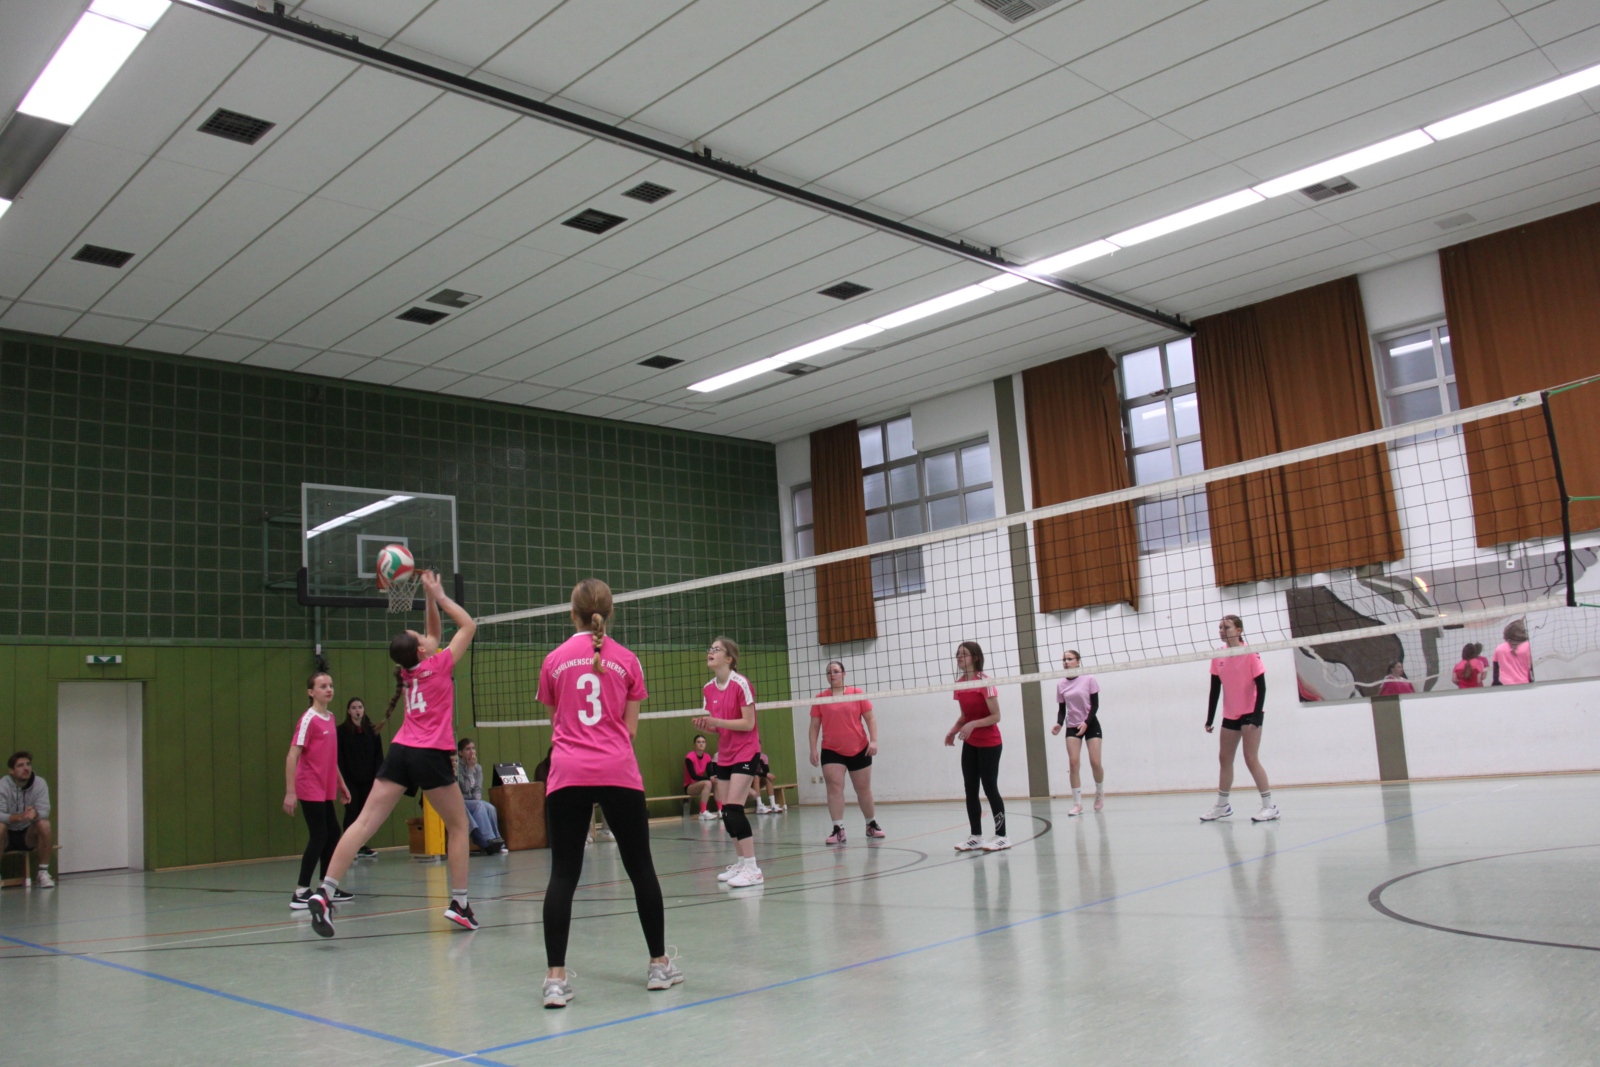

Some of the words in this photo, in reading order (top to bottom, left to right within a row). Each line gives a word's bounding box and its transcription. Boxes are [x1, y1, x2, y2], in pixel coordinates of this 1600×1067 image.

[552, 658, 606, 679] URSULINENSCHE
[606, 661, 627, 678] HERSEL
[403, 678, 427, 714] 14
[576, 673, 602, 726] 3
